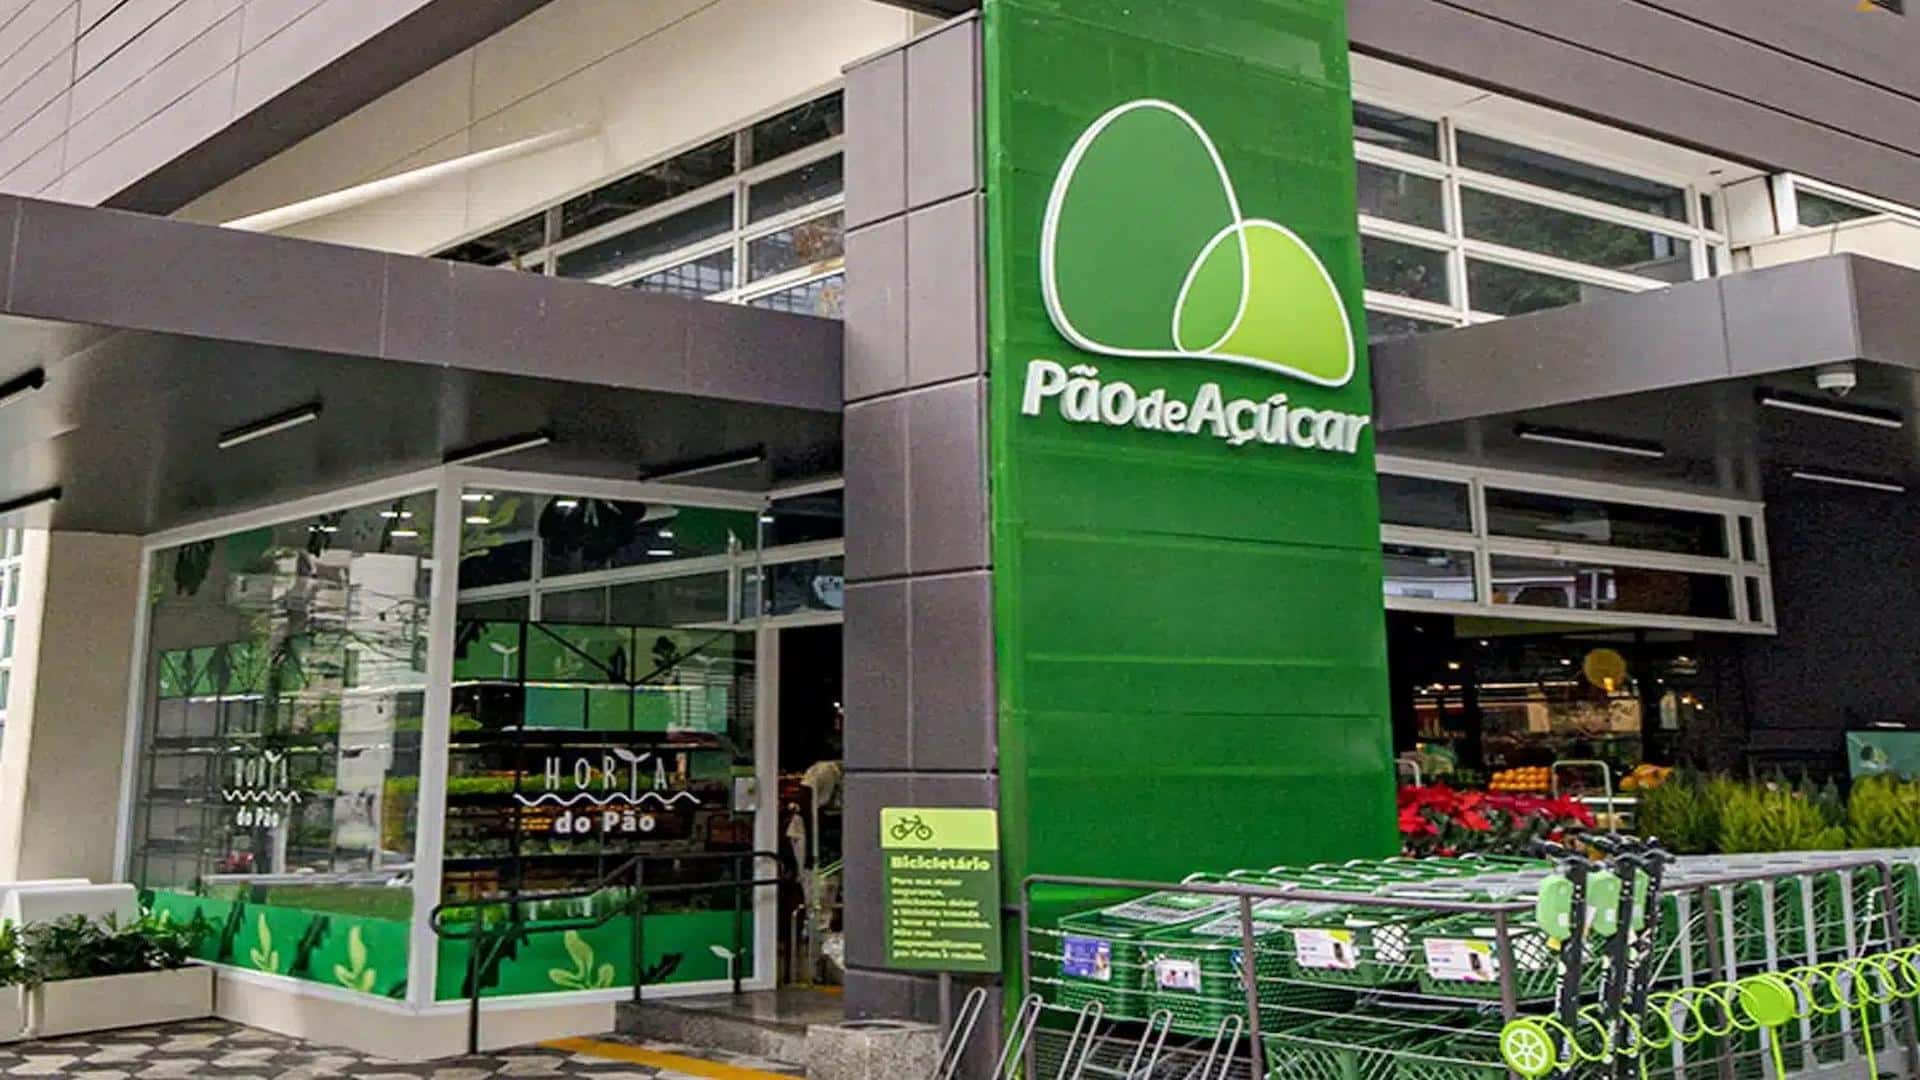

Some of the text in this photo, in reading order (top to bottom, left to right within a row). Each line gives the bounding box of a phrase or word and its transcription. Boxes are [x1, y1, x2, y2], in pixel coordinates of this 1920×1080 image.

[545, 749, 668, 801] HORTA
[555, 811, 656, 833] do Pão
[890, 855, 991, 871] Bicicletário
